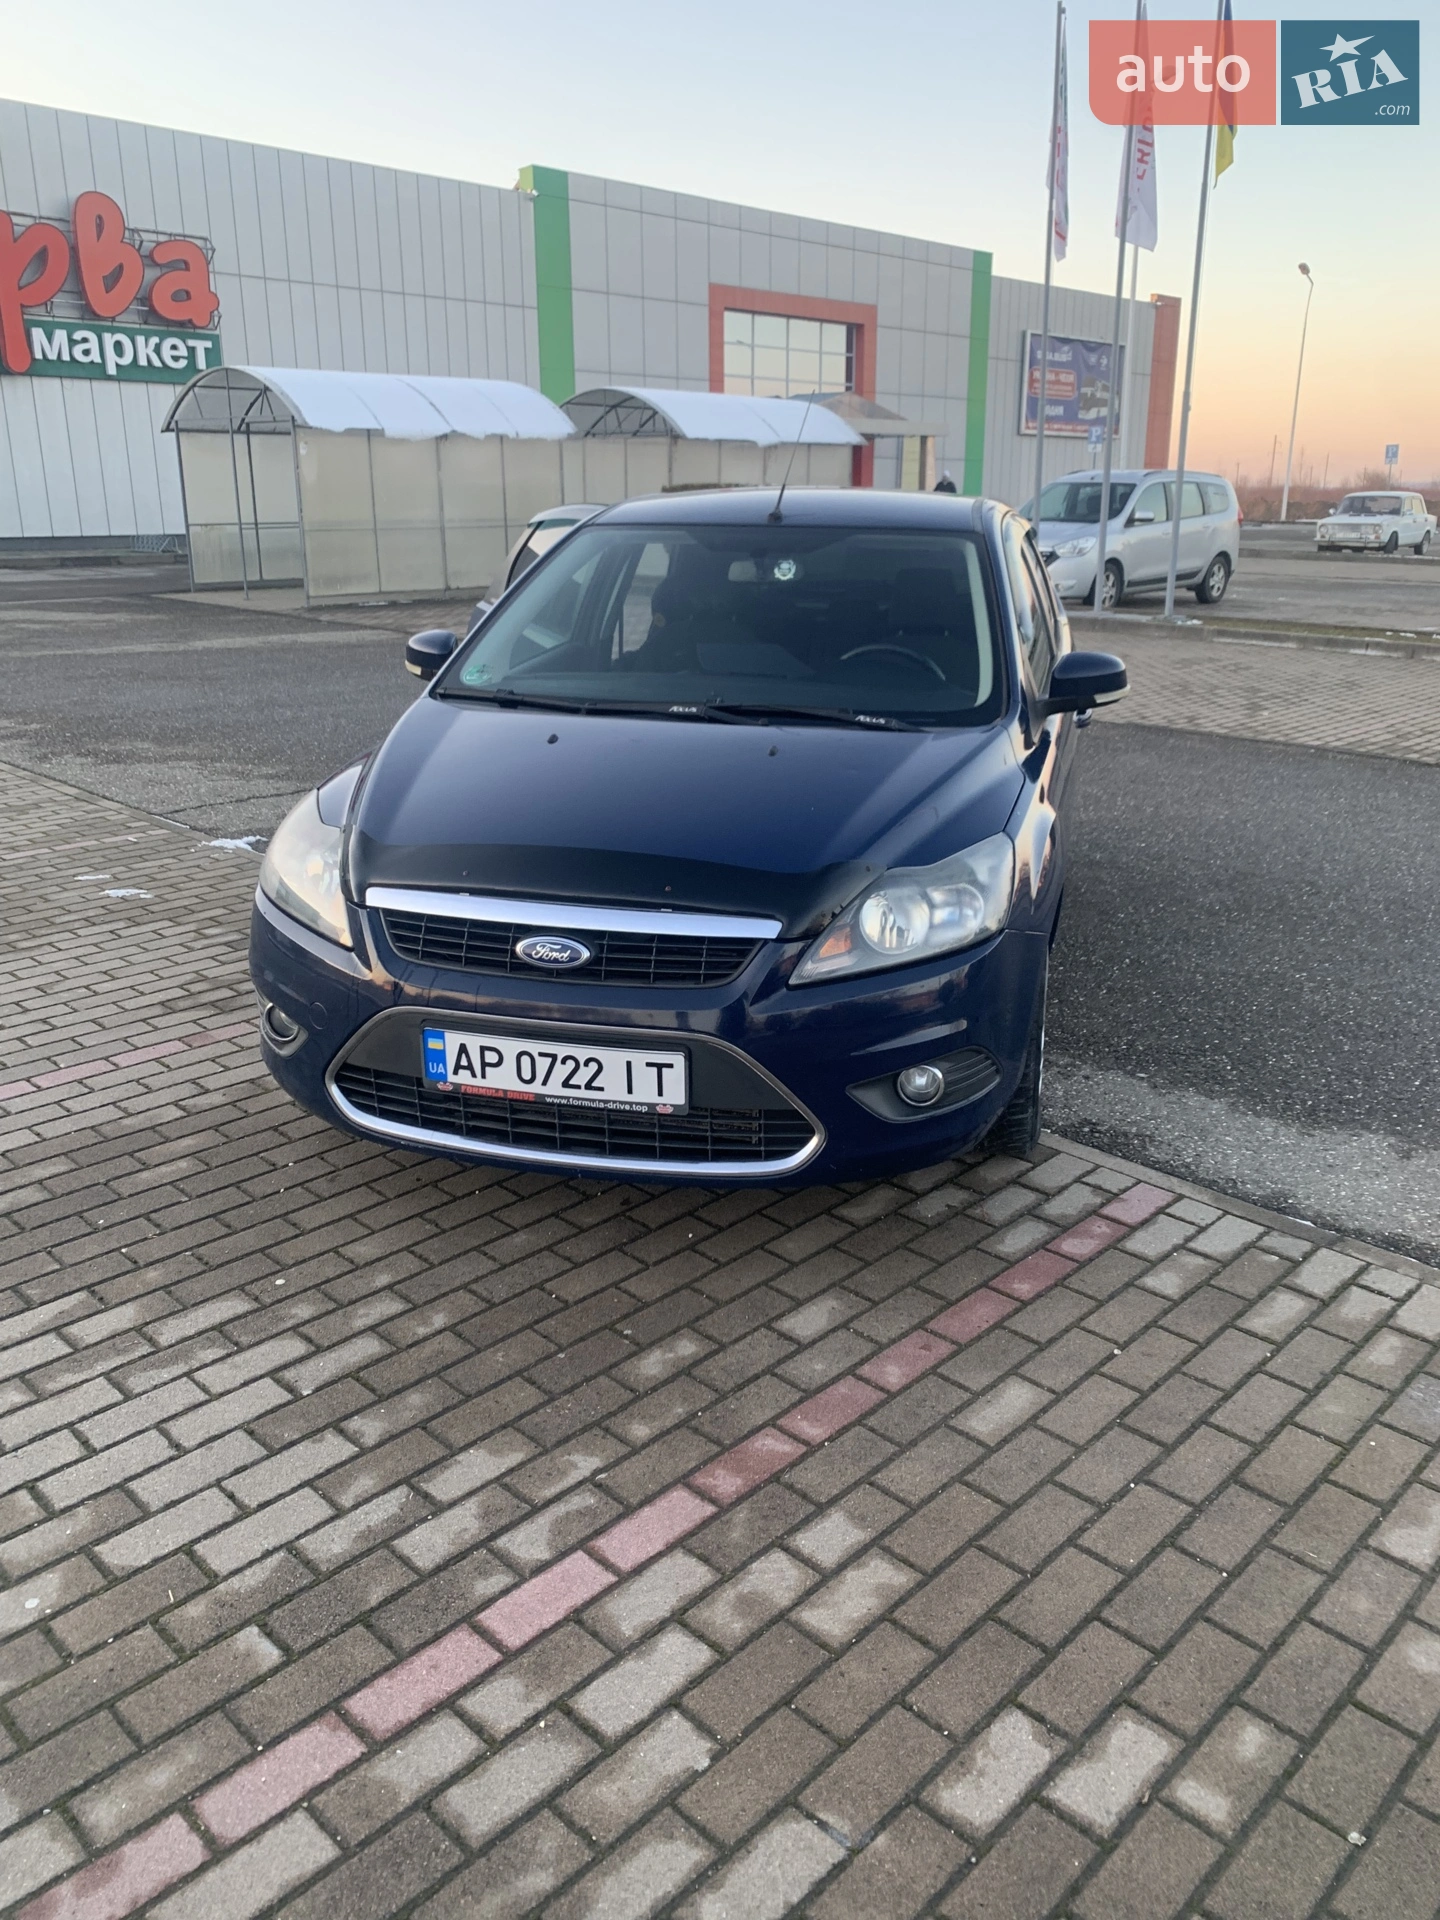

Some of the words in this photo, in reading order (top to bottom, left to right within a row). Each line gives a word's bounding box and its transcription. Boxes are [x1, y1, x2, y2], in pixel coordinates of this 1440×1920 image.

[30, 326, 213, 376] маркет
[532, 942, 571, 962] Ford
[428, 1061, 446, 1075] UA
[452, 1042, 504, 1080] AP
[515, 1050, 605, 1092] 0722
[460, 1085, 504, 1098] FORMULA
[506, 1091, 536, 1102] DRIVE
[544, 1095, 648, 1113] www.formula-drive.top
